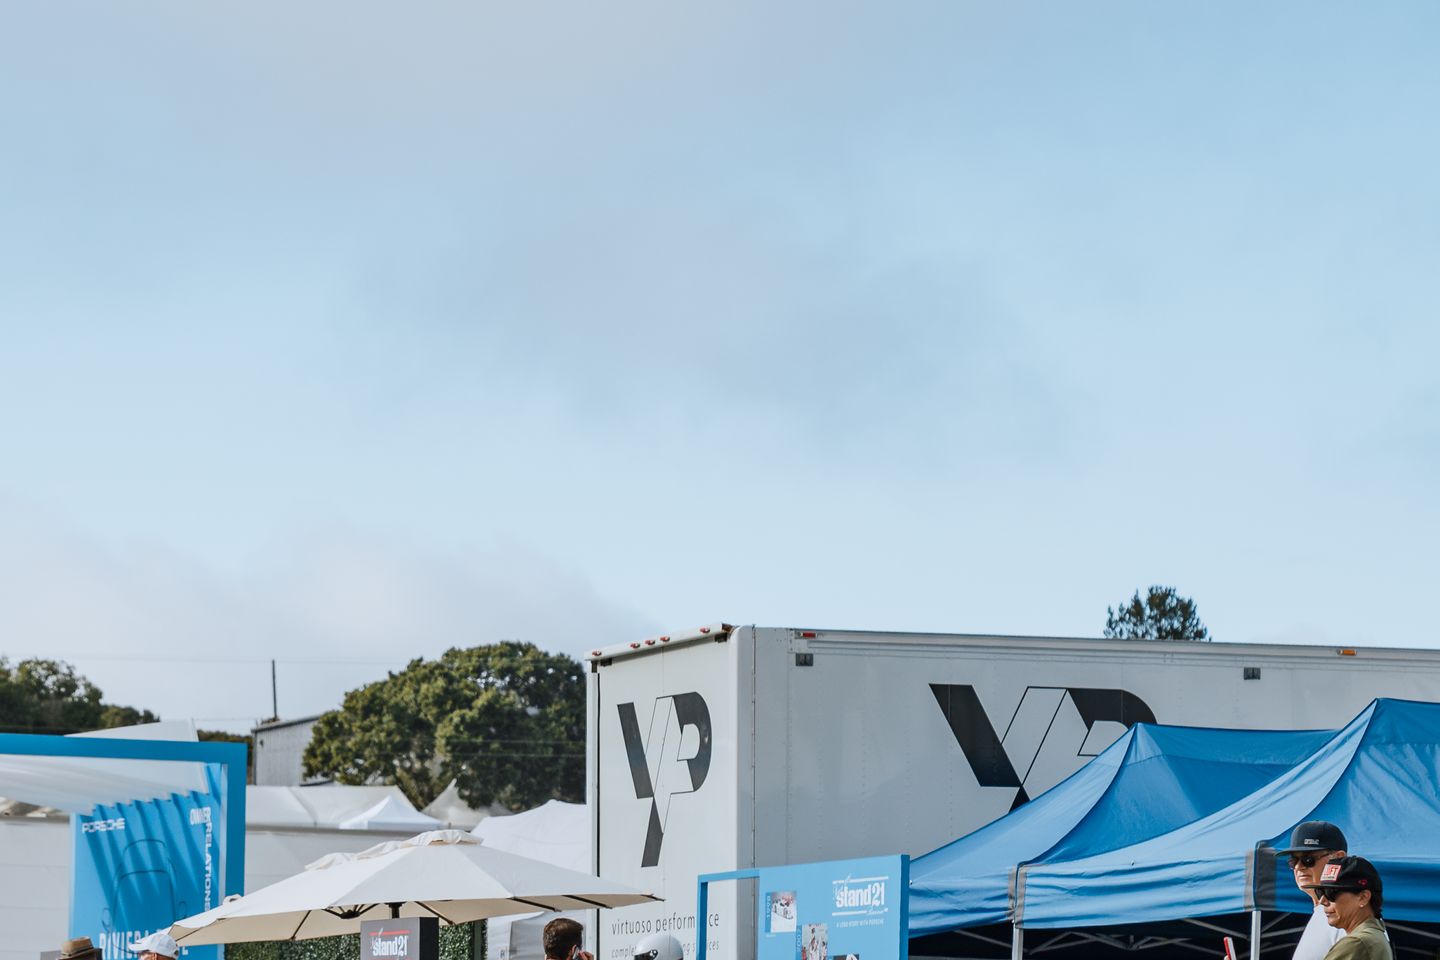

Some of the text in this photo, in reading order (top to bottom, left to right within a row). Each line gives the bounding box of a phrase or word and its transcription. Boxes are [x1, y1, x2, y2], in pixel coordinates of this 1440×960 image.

[82, 817, 126, 834] PORSCHE
[835, 881, 885, 908] stand21
[612, 911, 720, 935] virtuoso performce
